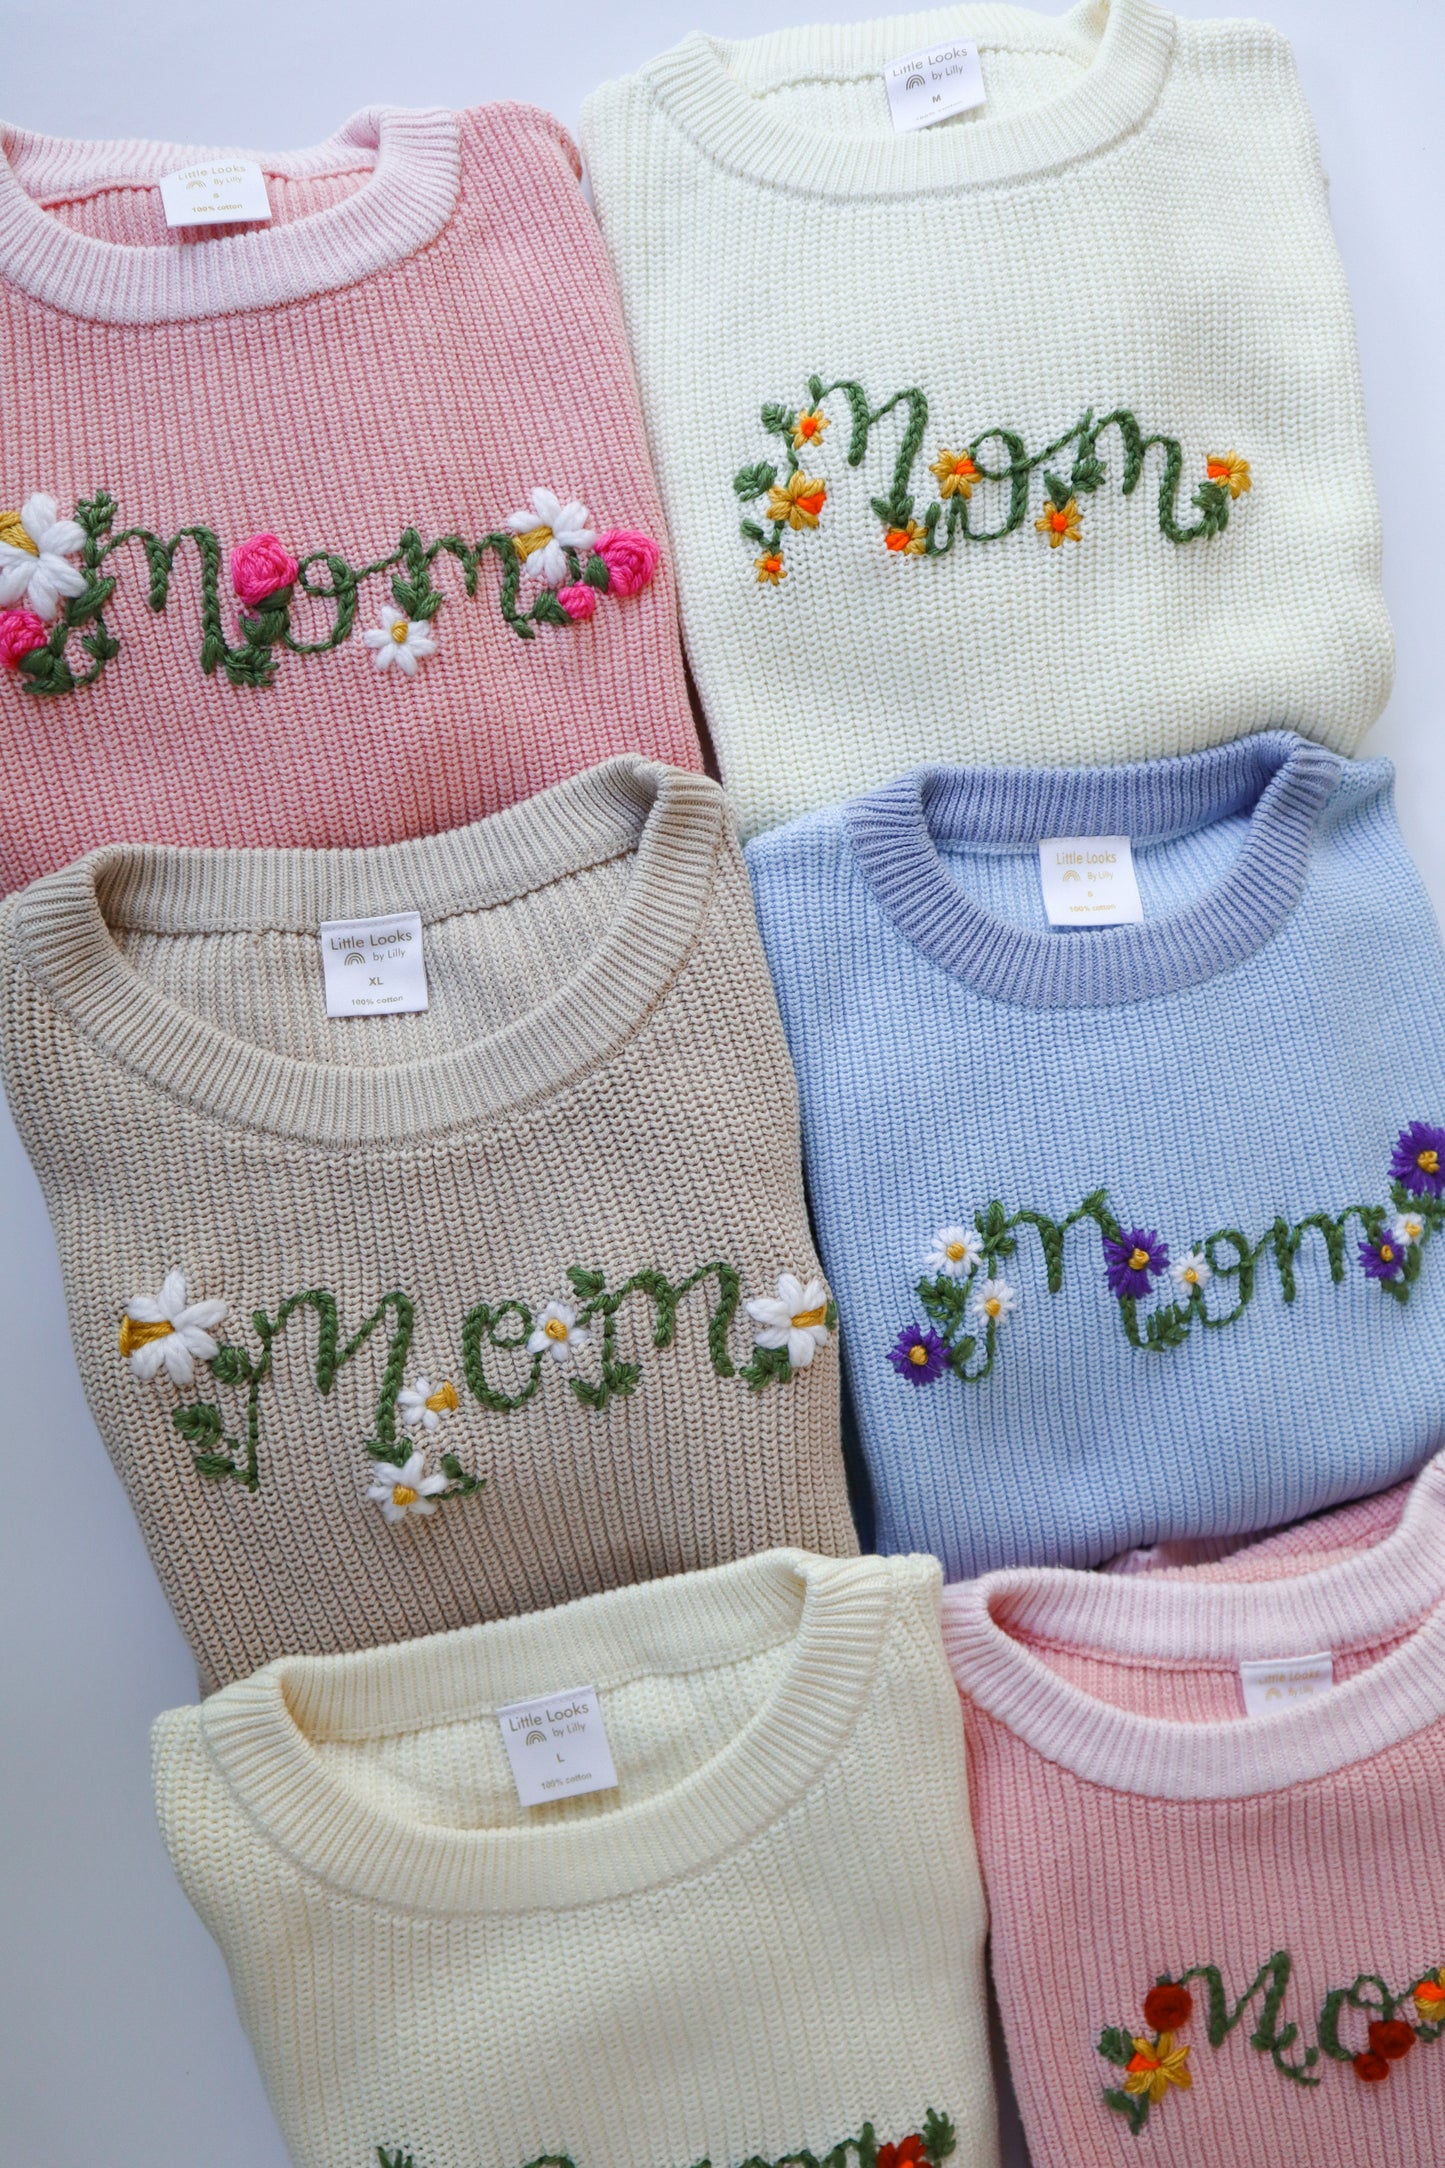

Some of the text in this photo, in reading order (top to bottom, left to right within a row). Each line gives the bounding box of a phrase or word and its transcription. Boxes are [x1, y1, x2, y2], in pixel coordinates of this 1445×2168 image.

[892, 47, 968, 77] Little Looks
[931, 64, 964, 81] by Lilly
[932, 94, 942, 103] M
[178, 164, 247, 181] Little Looks
[213, 175, 242, 187] By Lilly
[192, 203, 243, 213] 100% cotton
[1056, 850, 1118, 866] Little Looks
[330, 929, 413, 951] Little Looks
[372, 948, 406, 962] by Lilly
[368, 977, 384, 987] XL
[351, 994, 404, 1006] 100% cotton
[508, 1701, 590, 1733] Little Looks
[551, 1721, 586, 1738] by Lilly
[556, 1753, 565, 1763] L
[541, 1772, 593, 1790] 100% cotton
